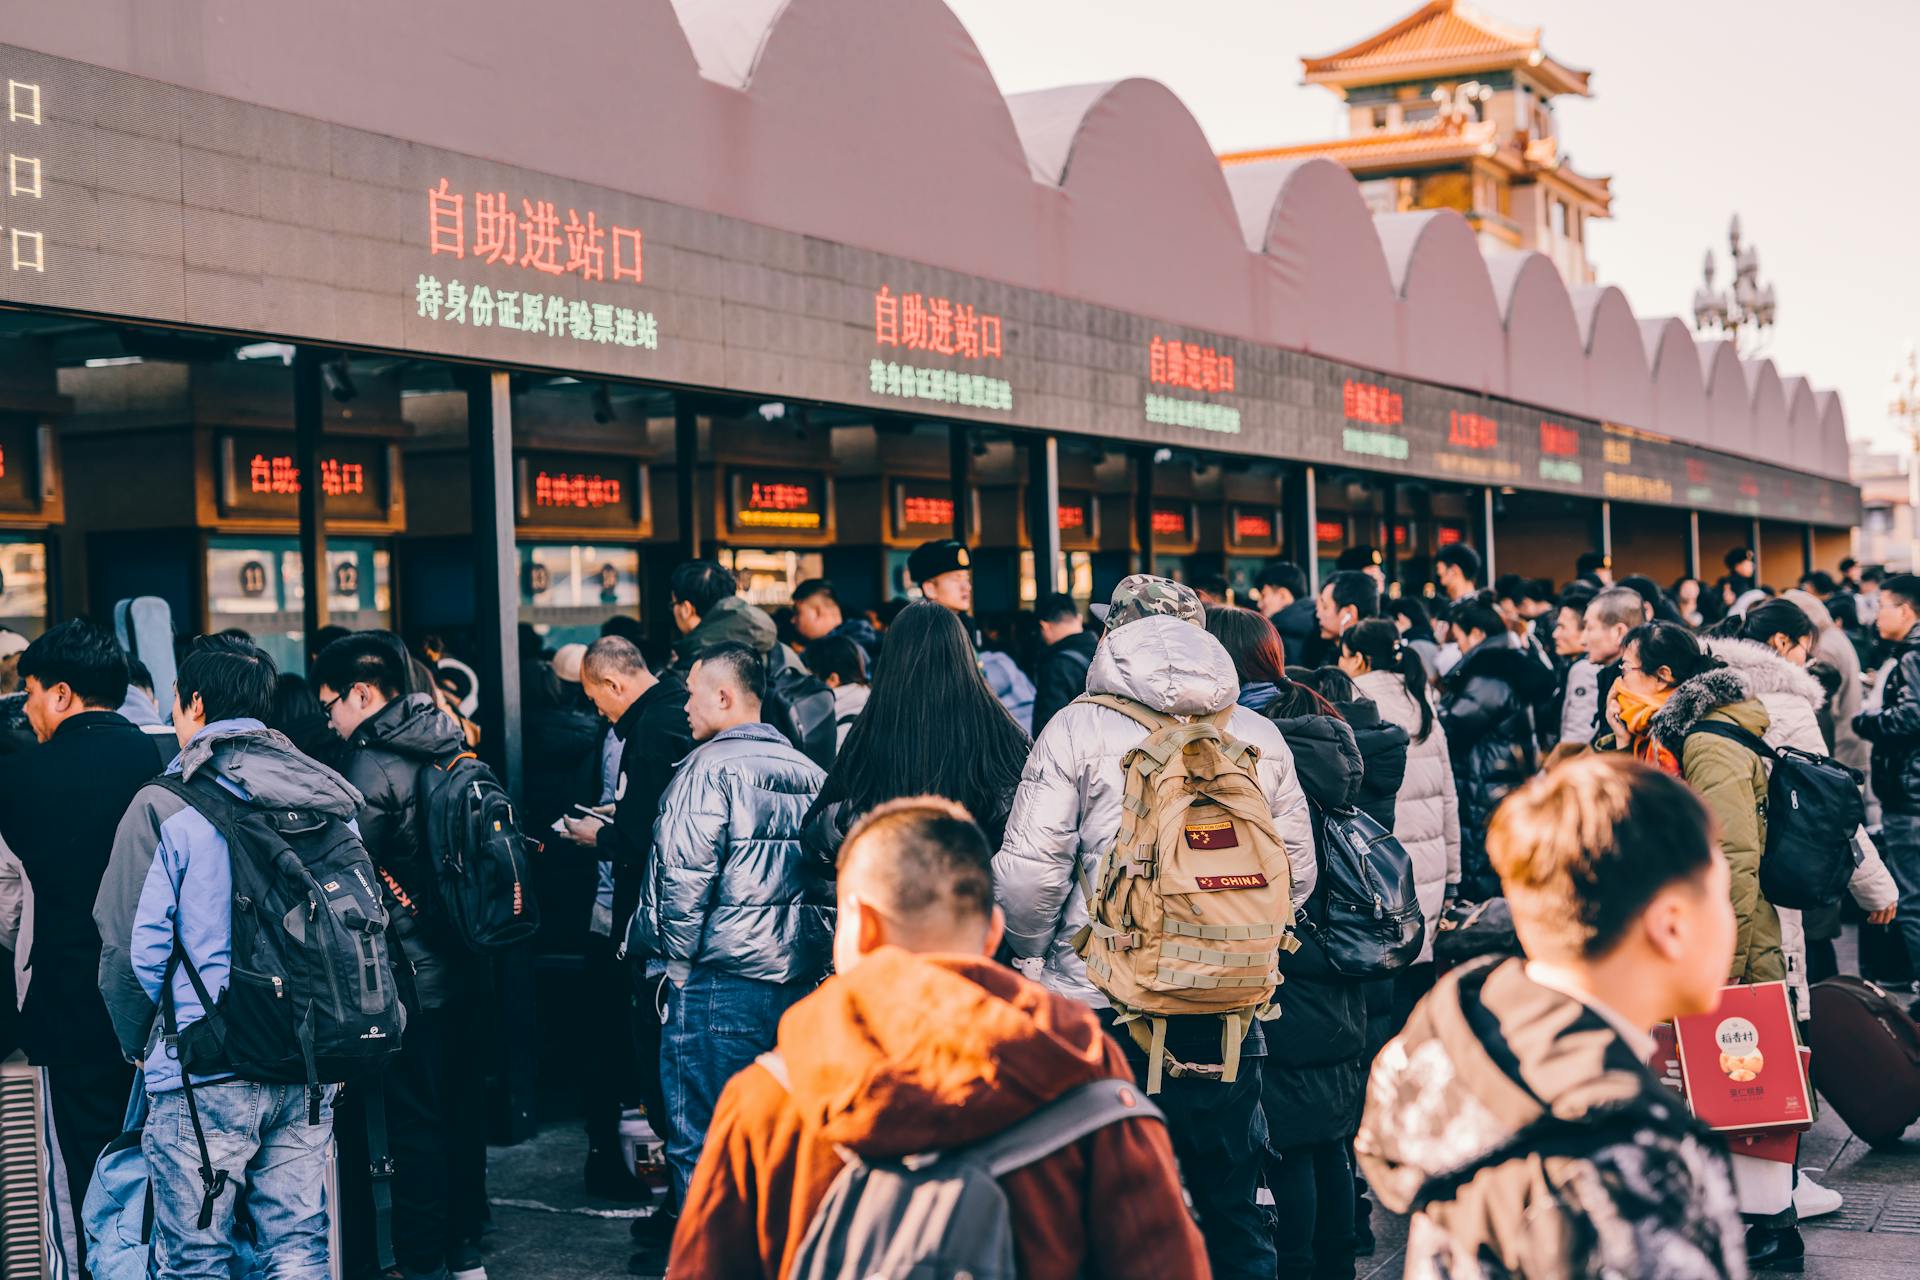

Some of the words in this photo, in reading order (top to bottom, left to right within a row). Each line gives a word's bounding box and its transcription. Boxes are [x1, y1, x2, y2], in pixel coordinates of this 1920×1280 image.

[8, 79, 41, 125] 口
[10, 153, 42, 198] 口
[428, 177, 644, 284] 自助进站口
[416, 274, 658, 349] 持身份证原件验票进站
[875, 284, 1003, 360] 自助进站口
[1220, 875, 1261, 887] CHINA
